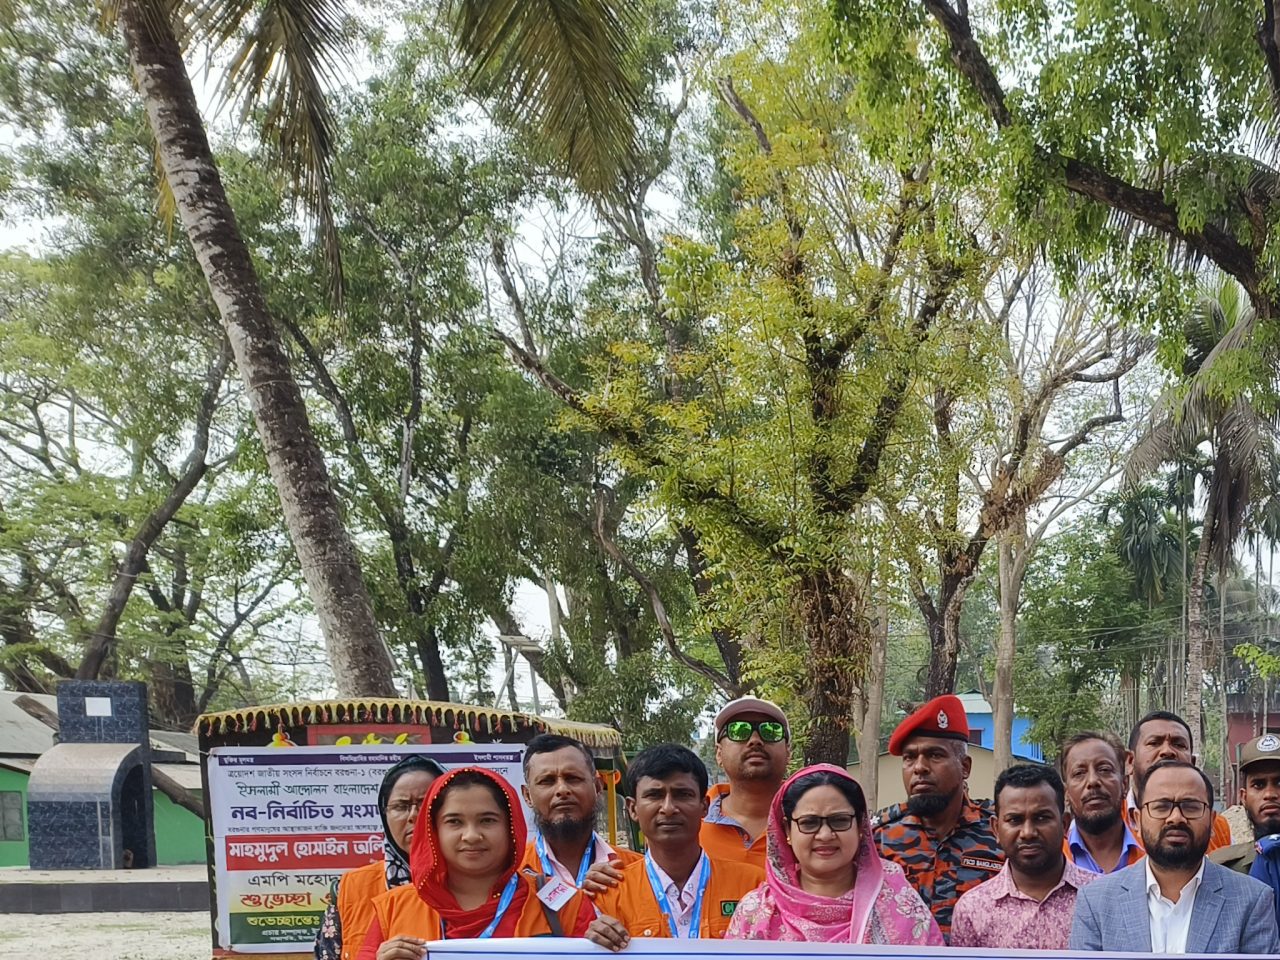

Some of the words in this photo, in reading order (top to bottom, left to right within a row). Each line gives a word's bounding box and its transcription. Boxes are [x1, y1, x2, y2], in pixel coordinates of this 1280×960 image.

[257, 768, 280, 778] জাতীয়
[282, 770, 303, 778] সংসদ
[305, 767, 332, 778] নির্বাচনে
[235, 781, 280, 797] ইসলামী
[283, 783, 329, 796] আন্দোলন
[333, 783, 379, 796] বাংলাদেশ
[230, 800, 334, 821] নব-নির্বাচিত
[228, 841, 288, 863] মাহমুদুল
[294, 837, 348, 858] হোসাইন
[248, 871, 290, 887] এমপি
[240, 891, 312, 909] শুভেচ্ছা
